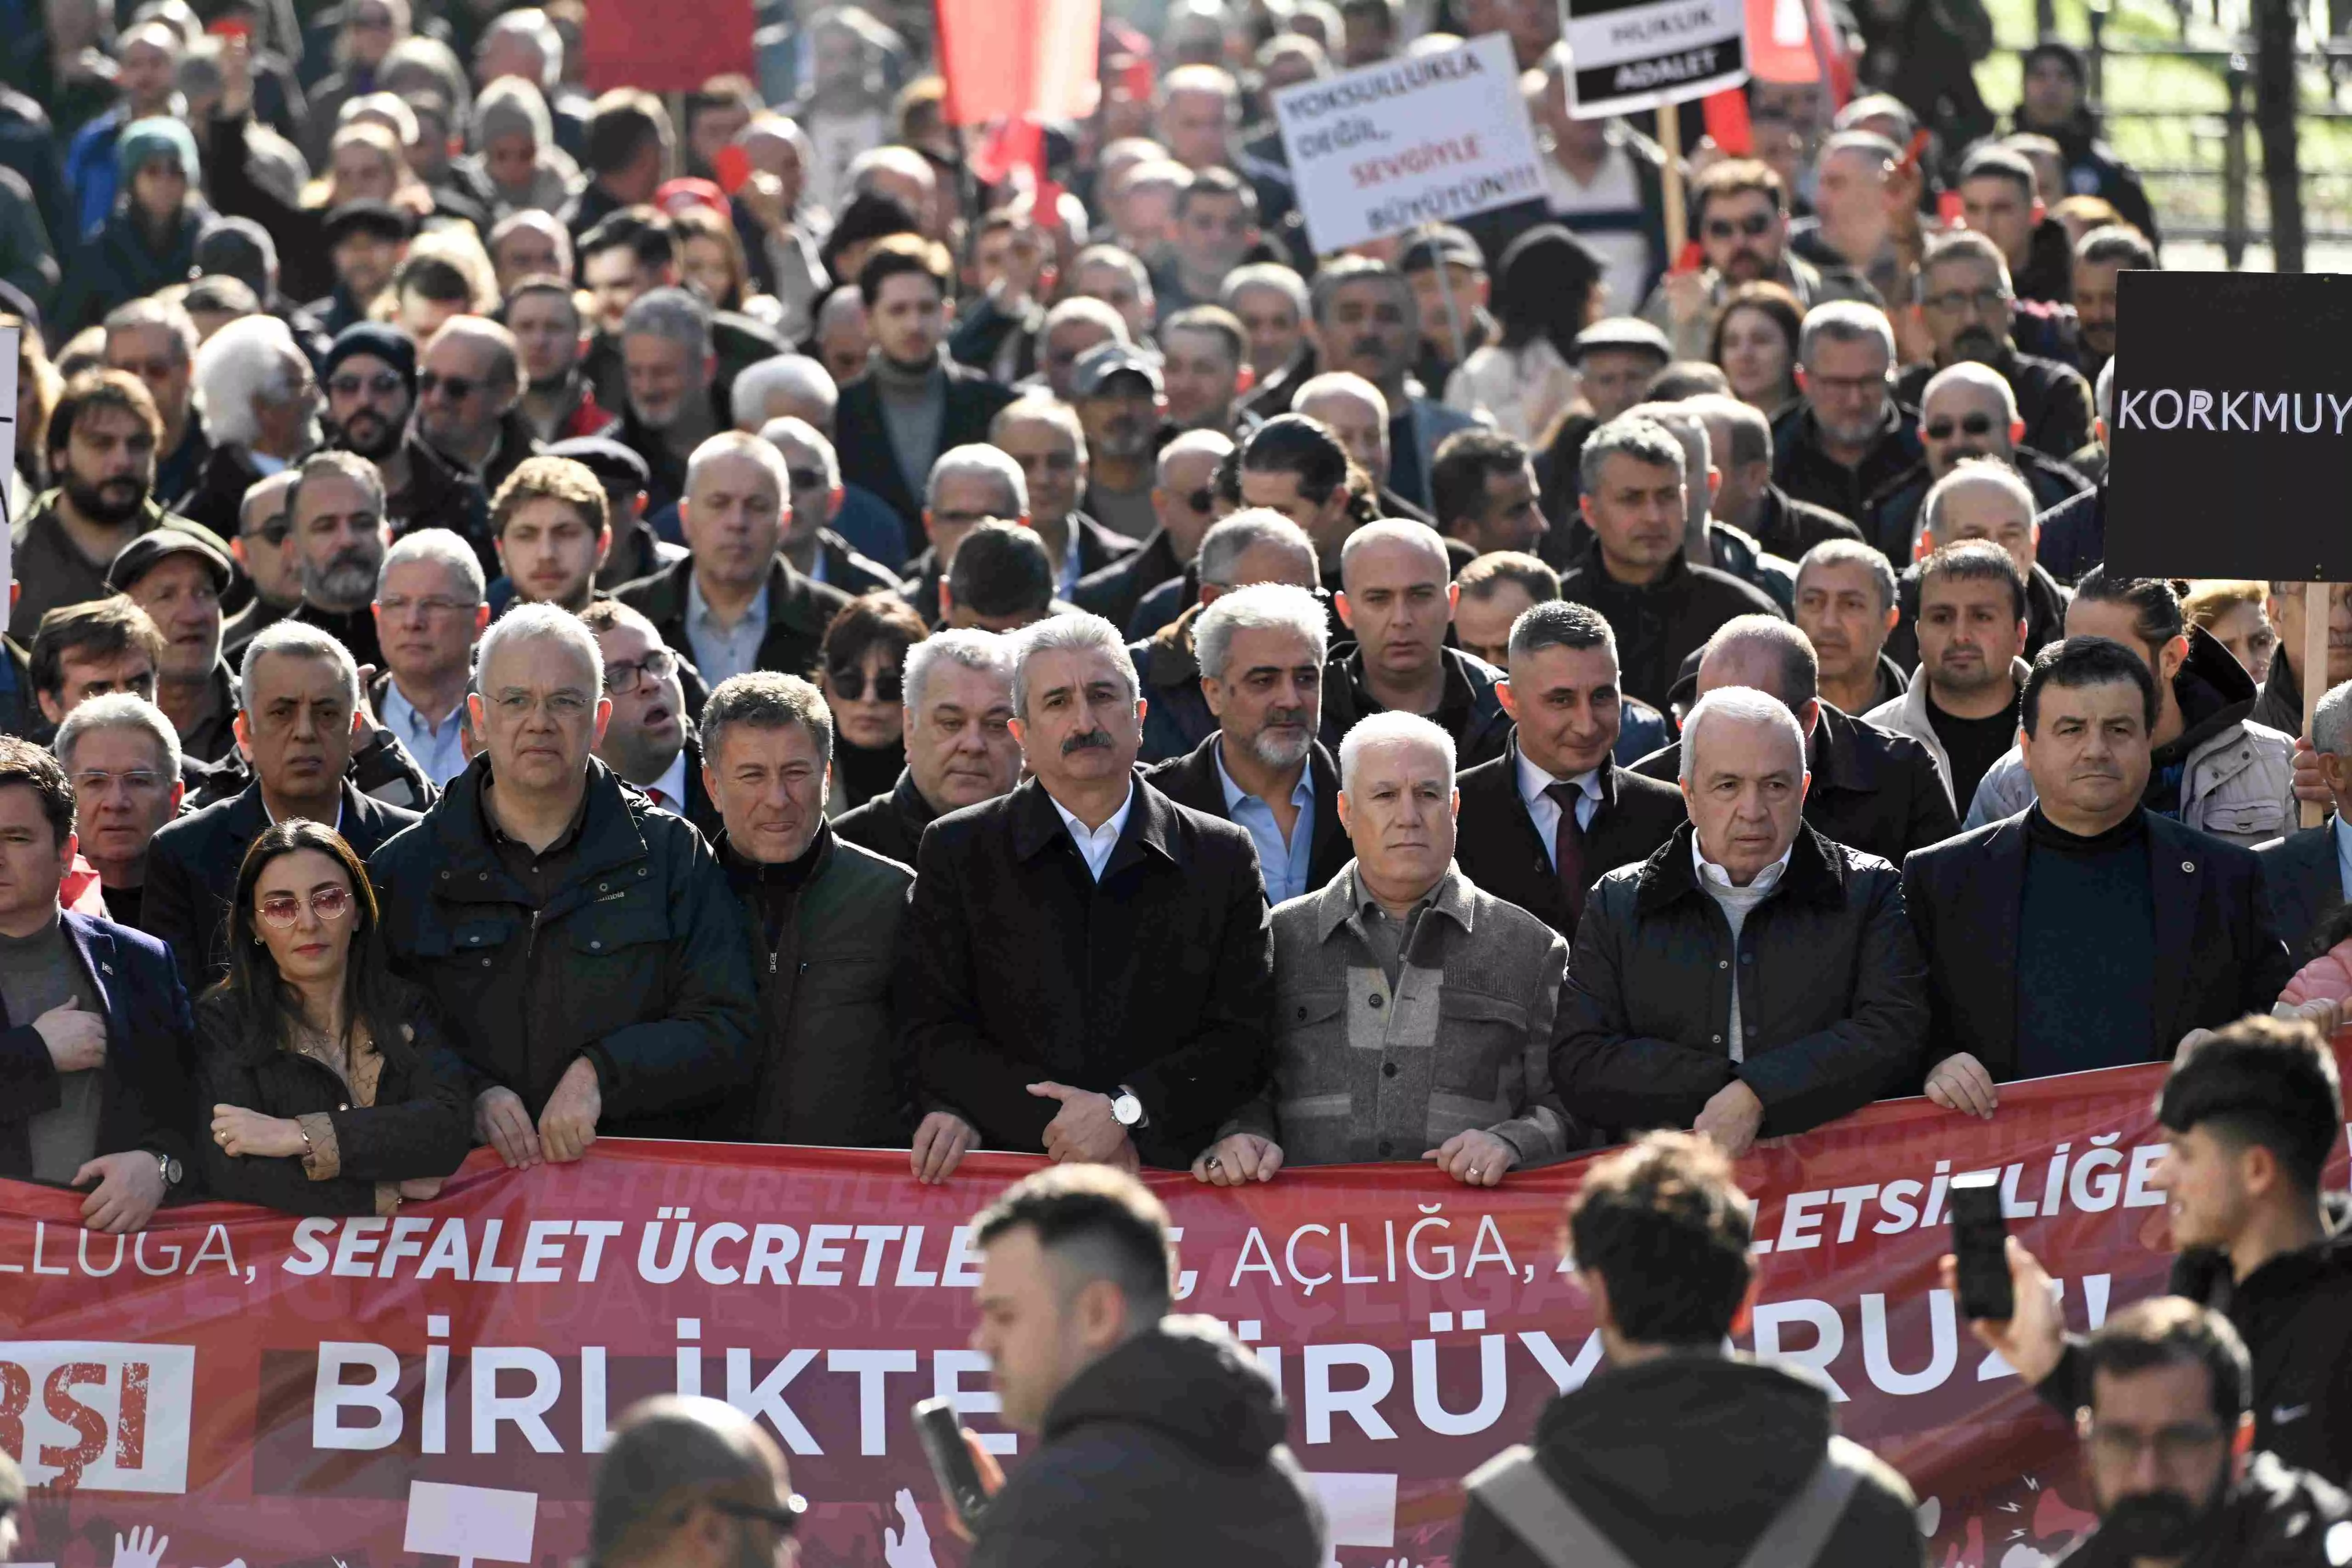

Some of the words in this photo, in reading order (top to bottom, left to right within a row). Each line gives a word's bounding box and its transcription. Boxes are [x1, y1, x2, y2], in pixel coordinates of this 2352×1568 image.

[2118, 389, 2352, 435] KORKMUY
[281, 1217, 624, 1283] SEFALET
[1230, 1203, 1534, 1296] AÇLIĞA,
